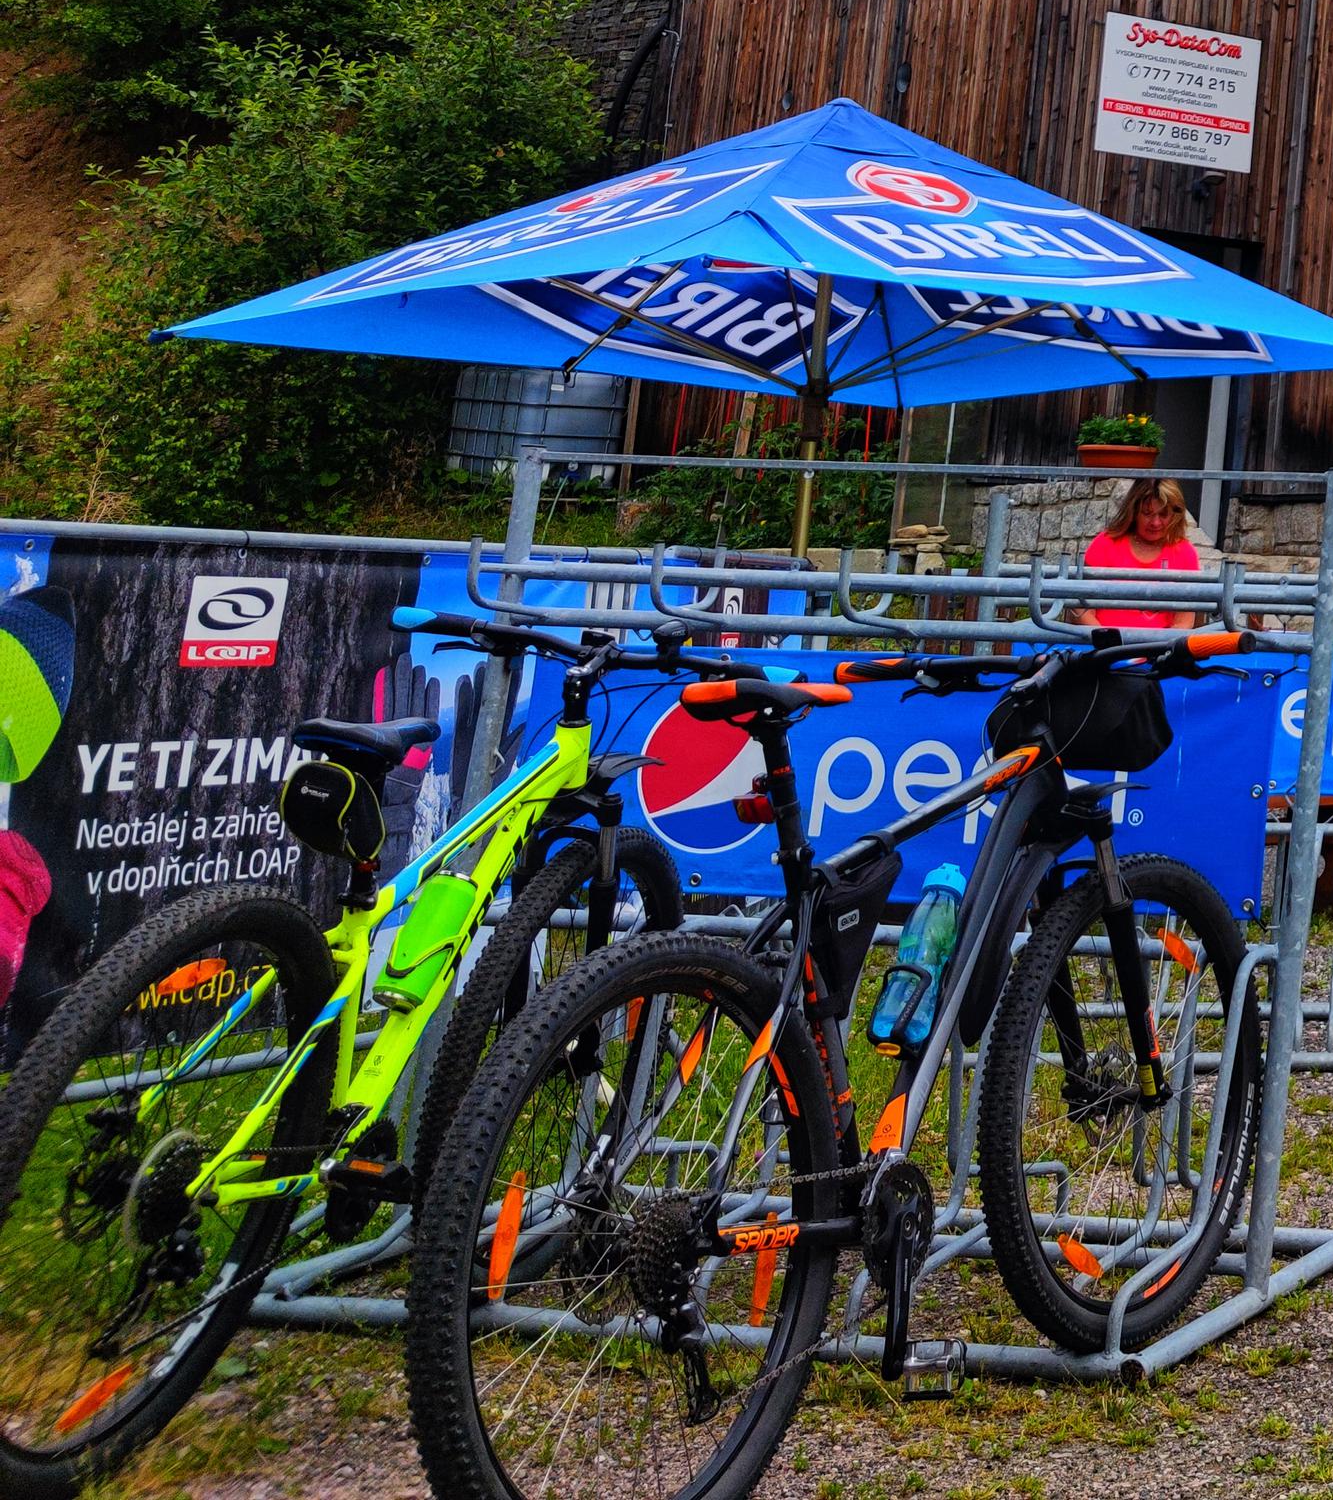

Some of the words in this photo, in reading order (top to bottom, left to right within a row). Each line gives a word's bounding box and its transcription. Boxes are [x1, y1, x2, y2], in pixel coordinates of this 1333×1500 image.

[1143, 66, 1171, 82] 777
[1176, 72, 1203, 87] 774
[1208, 78, 1236, 93] 215
[1148, 85, 1213, 100] www.sys-data.com
[1137, 120, 1166, 136] 777
[1171, 126, 1199, 142] 866
[1204, 131, 1232, 147] 797
[1148, 108, 1179, 120] MARTIN
[358, 187, 694, 284] BIRELL
[832, 213, 1148, 264] BIRELL
[77, 742, 140, 794] YE
[151, 739, 194, 790] TI
[200, 736, 330, 787] ZIMA
[75, 810, 189, 850] Neotálej
[192, 816, 207, 841] a
[86, 870, 103, 896] v
[107, 851, 230, 899] doplňcích
[235, 845, 301, 881] LOAP
[1217, 1081, 1255, 1227] SCHWALBE
[731, 1223, 800, 1256] SPIDER
